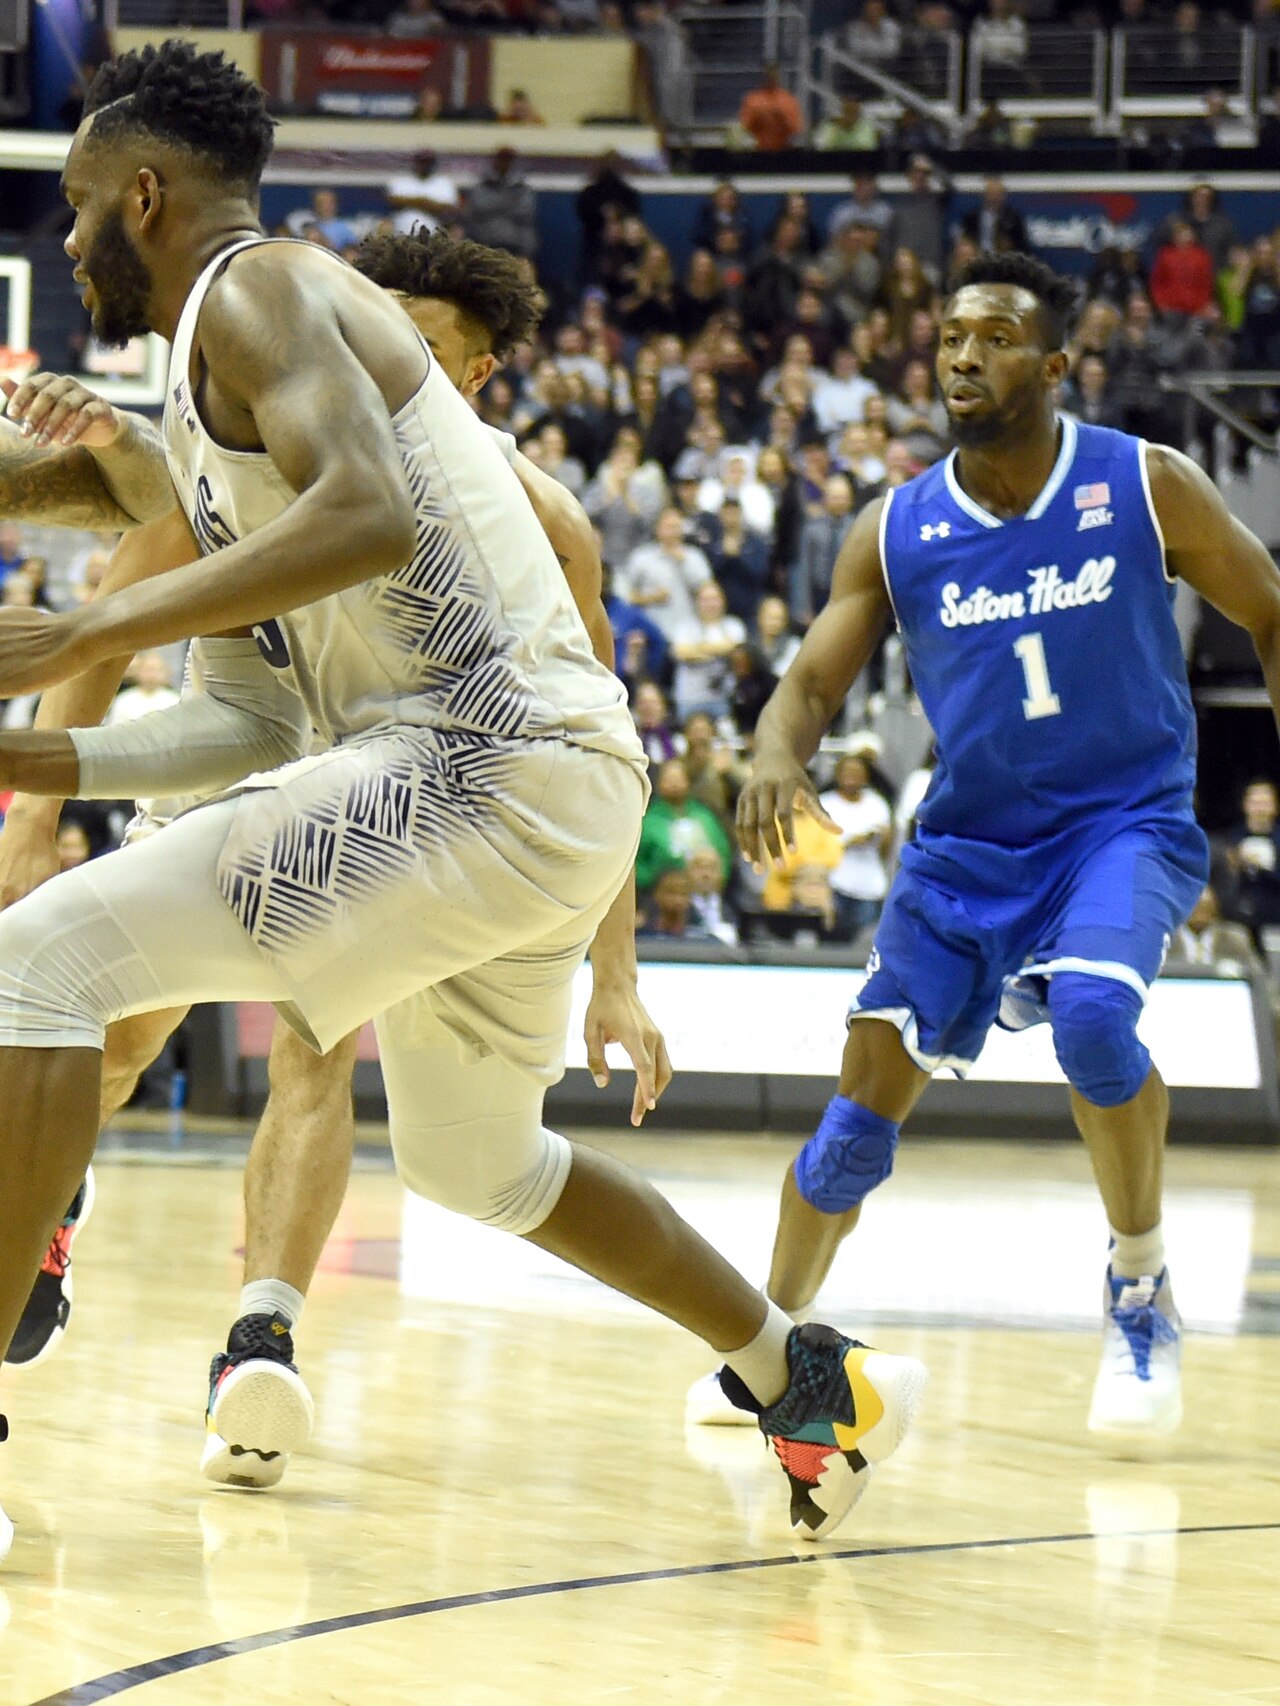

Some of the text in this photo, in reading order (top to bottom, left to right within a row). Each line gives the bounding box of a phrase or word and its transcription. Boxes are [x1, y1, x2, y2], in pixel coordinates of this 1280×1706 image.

[940, 555, 1116, 628] Seton Hall
[1012, 631, 1061, 721] 1
